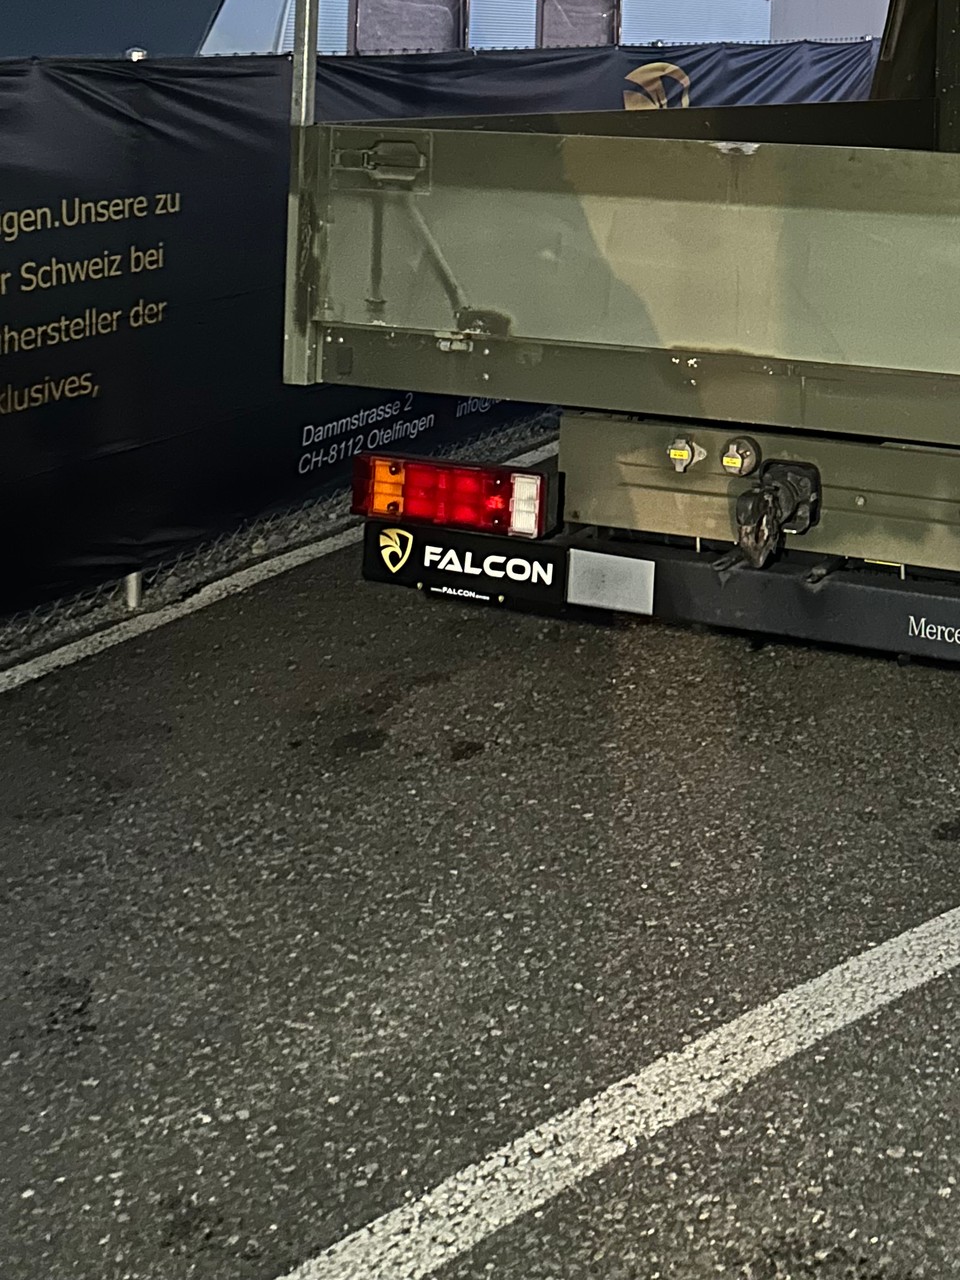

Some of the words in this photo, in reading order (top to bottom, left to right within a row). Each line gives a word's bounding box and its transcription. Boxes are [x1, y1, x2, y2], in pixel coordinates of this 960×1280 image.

[0, 196, 148, 242] gen.Unsere
[155, 192, 181, 215] zu
[20, 250, 122, 291] Schweiz
[130, 242, 164, 273] bei
[0, 308, 122, 355] hersteller
[129, 299, 167, 328] der
[298, 434, 364, 474] CH-8112
[366, 413, 435, 449] Otelfingen
[302, 401, 401, 447] Dammstrasse
[403, 392, 414, 412] 2
[423, 545, 553, 586] FALCON
